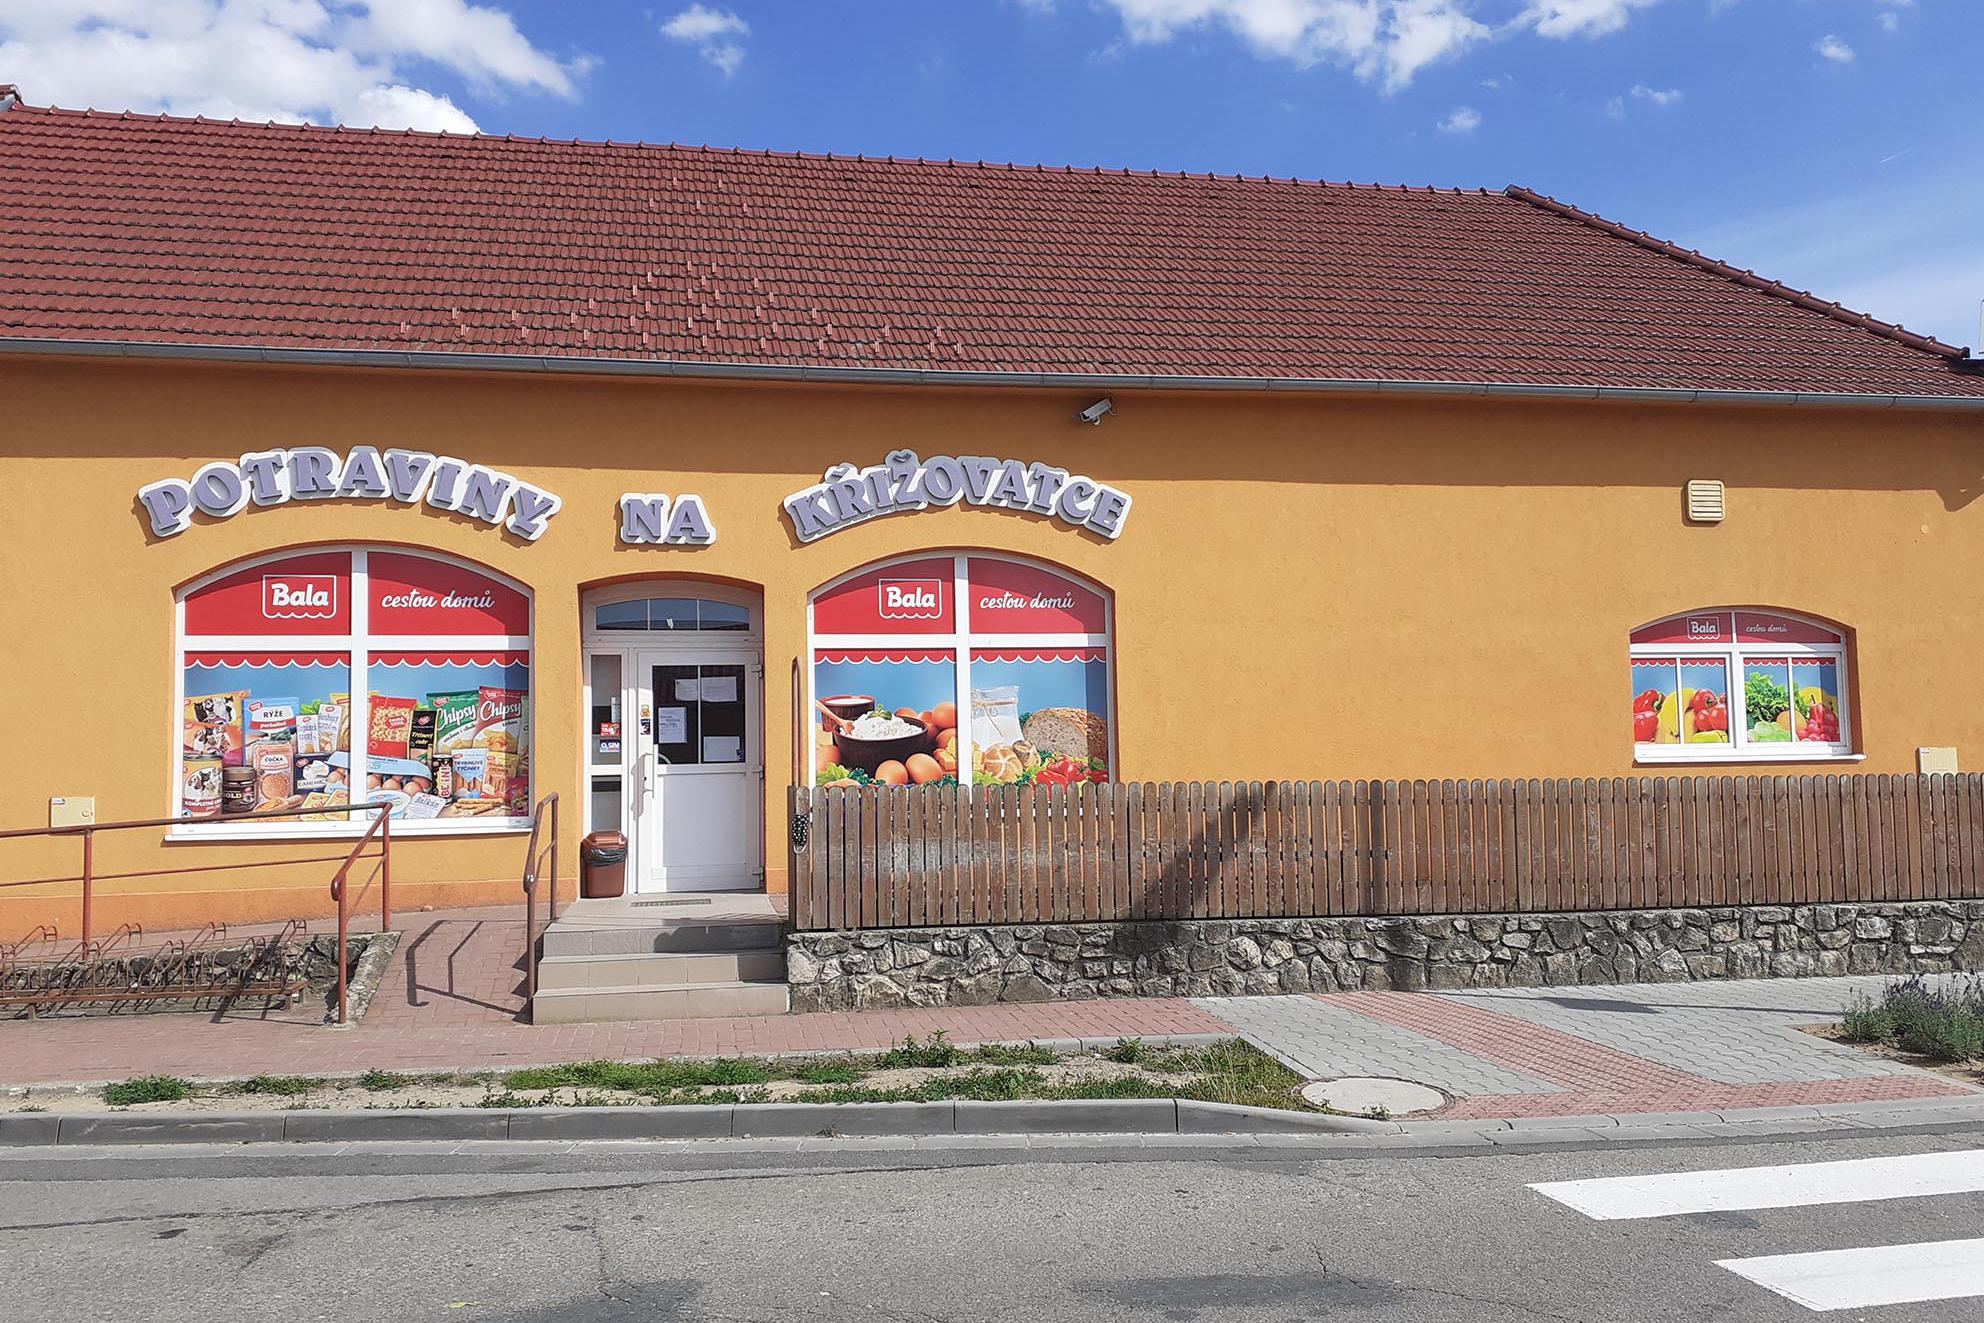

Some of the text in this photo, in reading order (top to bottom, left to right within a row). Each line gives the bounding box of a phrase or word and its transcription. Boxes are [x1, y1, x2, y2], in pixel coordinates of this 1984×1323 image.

[141, 447, 1131, 540] POTRAVINY NA KŘIŽOVATCE
[271, 582, 330, 608] Bala
[381, 588, 495, 608] cestou domů
[885, 586, 936, 608] Bala
[979, 590, 1076, 609] cestou domů
[1690, 621, 1717, 633] Bala
[1745, 623, 1767, 633] cestou
[263, 710, 283, 719] RÝŽE
[437, 704, 476, 731] Chipsy
[480, 700, 522, 721] Chipsy
